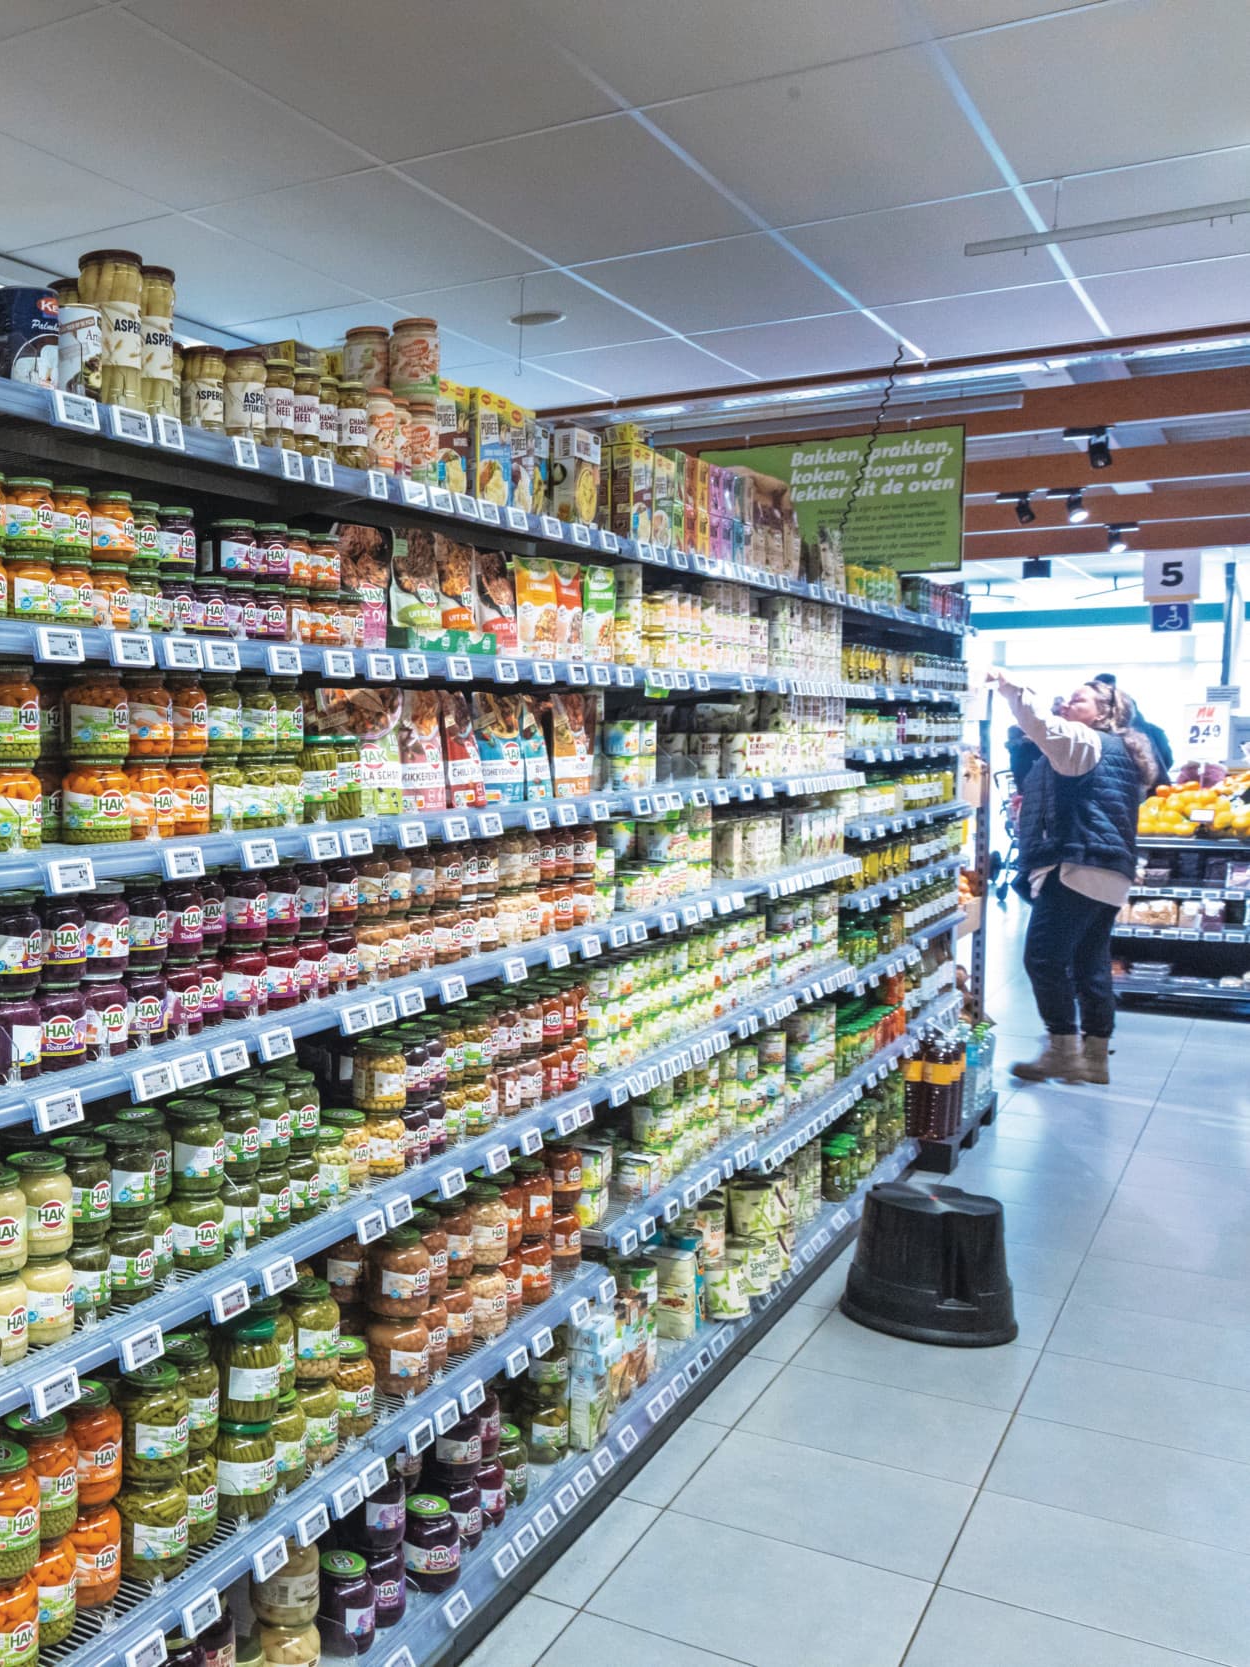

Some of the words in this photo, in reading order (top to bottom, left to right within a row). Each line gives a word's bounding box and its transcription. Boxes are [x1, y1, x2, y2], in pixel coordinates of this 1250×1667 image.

[791, 448, 864, 467] Bakken,
[869, 440, 954, 464] prakken,
[791, 467, 850, 485] koken,
[923, 456, 946, 478] of
[791, 484, 847, 502] lekker
[881, 479, 903, 495] de
[908, 478, 955, 493] oven
[1160, 561, 1184, 587] 5
[1189, 724, 1221, 744] 2.49
[53, 931, 80, 946] HAK
[45, 1023, 74, 1039] HAK
[37, 1207, 66, 1223] HAK
[195, 1229, 219, 1242] HAK
[94, 1451, 118, 1466] HAK
[13, 1512, 38, 1531] HAK
[96, 1552, 117, 1568] HAK
[10, 1629, 34, 1646] HAK
